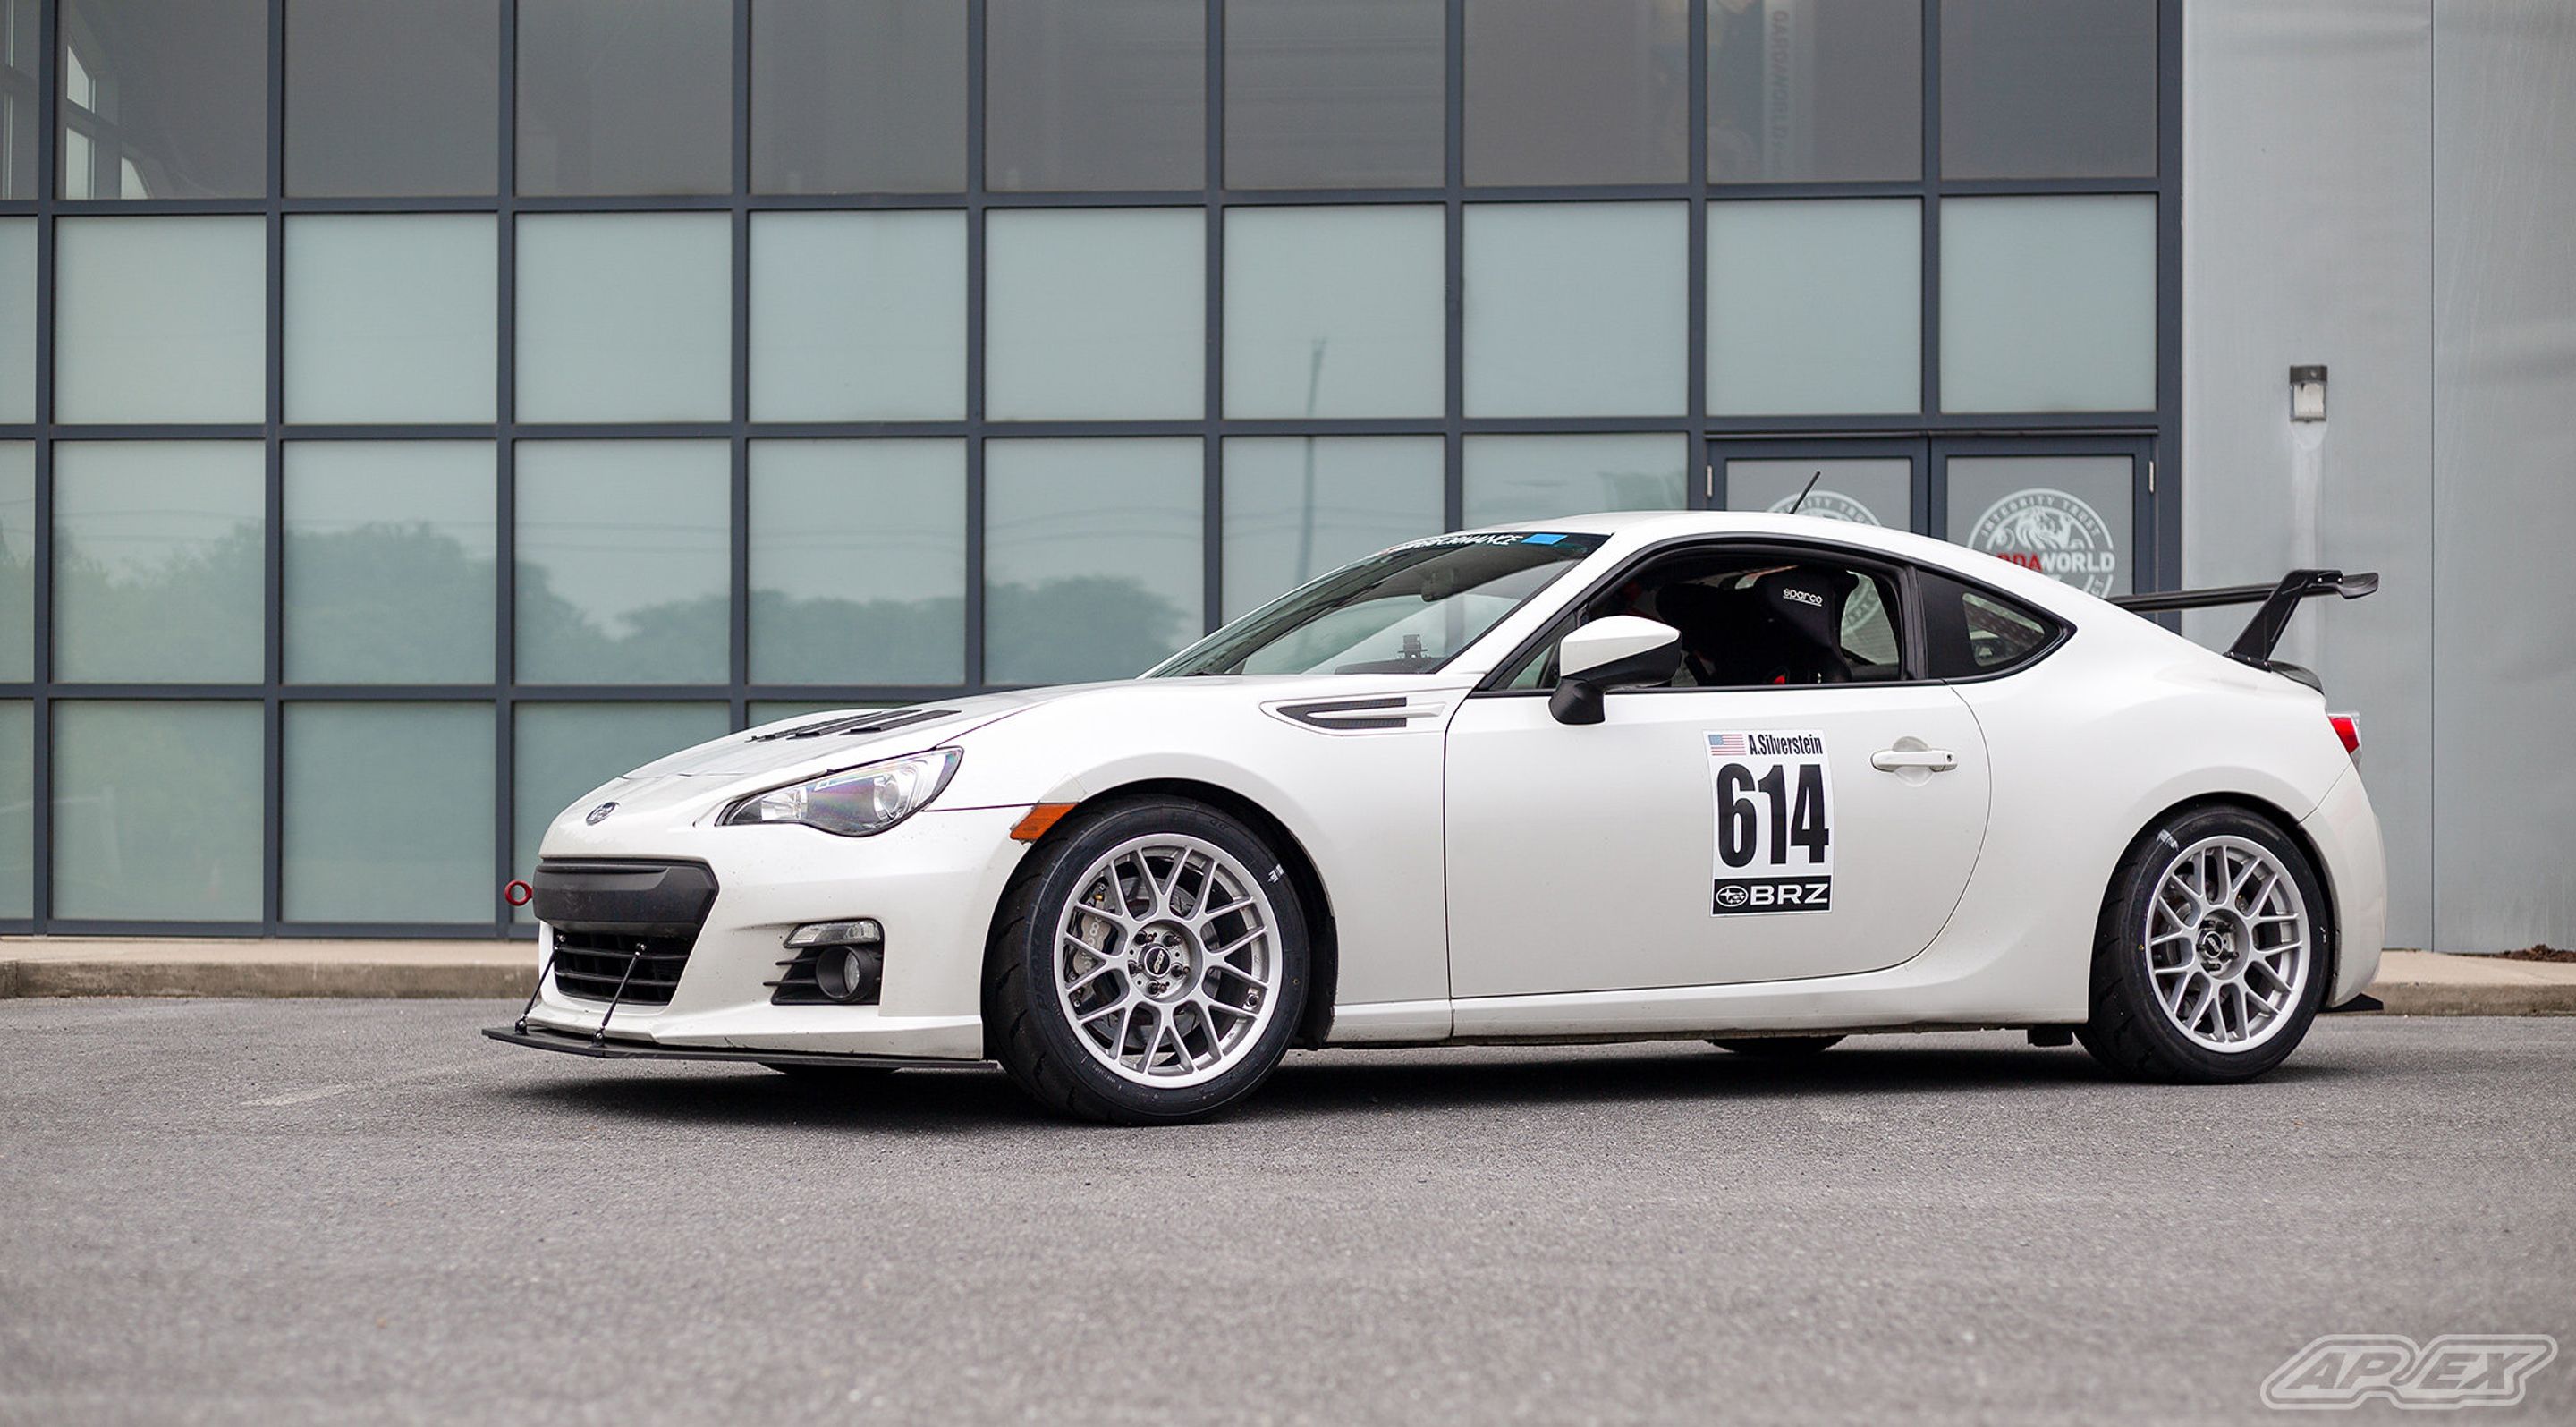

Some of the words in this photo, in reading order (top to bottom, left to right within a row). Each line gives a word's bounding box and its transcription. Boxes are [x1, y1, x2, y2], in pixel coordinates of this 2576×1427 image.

[2063, 500, 2101, 535] TRUST
[1996, 551, 2115, 573] DAWORLD
[1784, 588, 1823, 606] sparco
[1748, 734, 1824, 755] A.Silverstein
[1716, 763, 1829, 868] 614
[1750, 883, 1829, 905] BRZ
